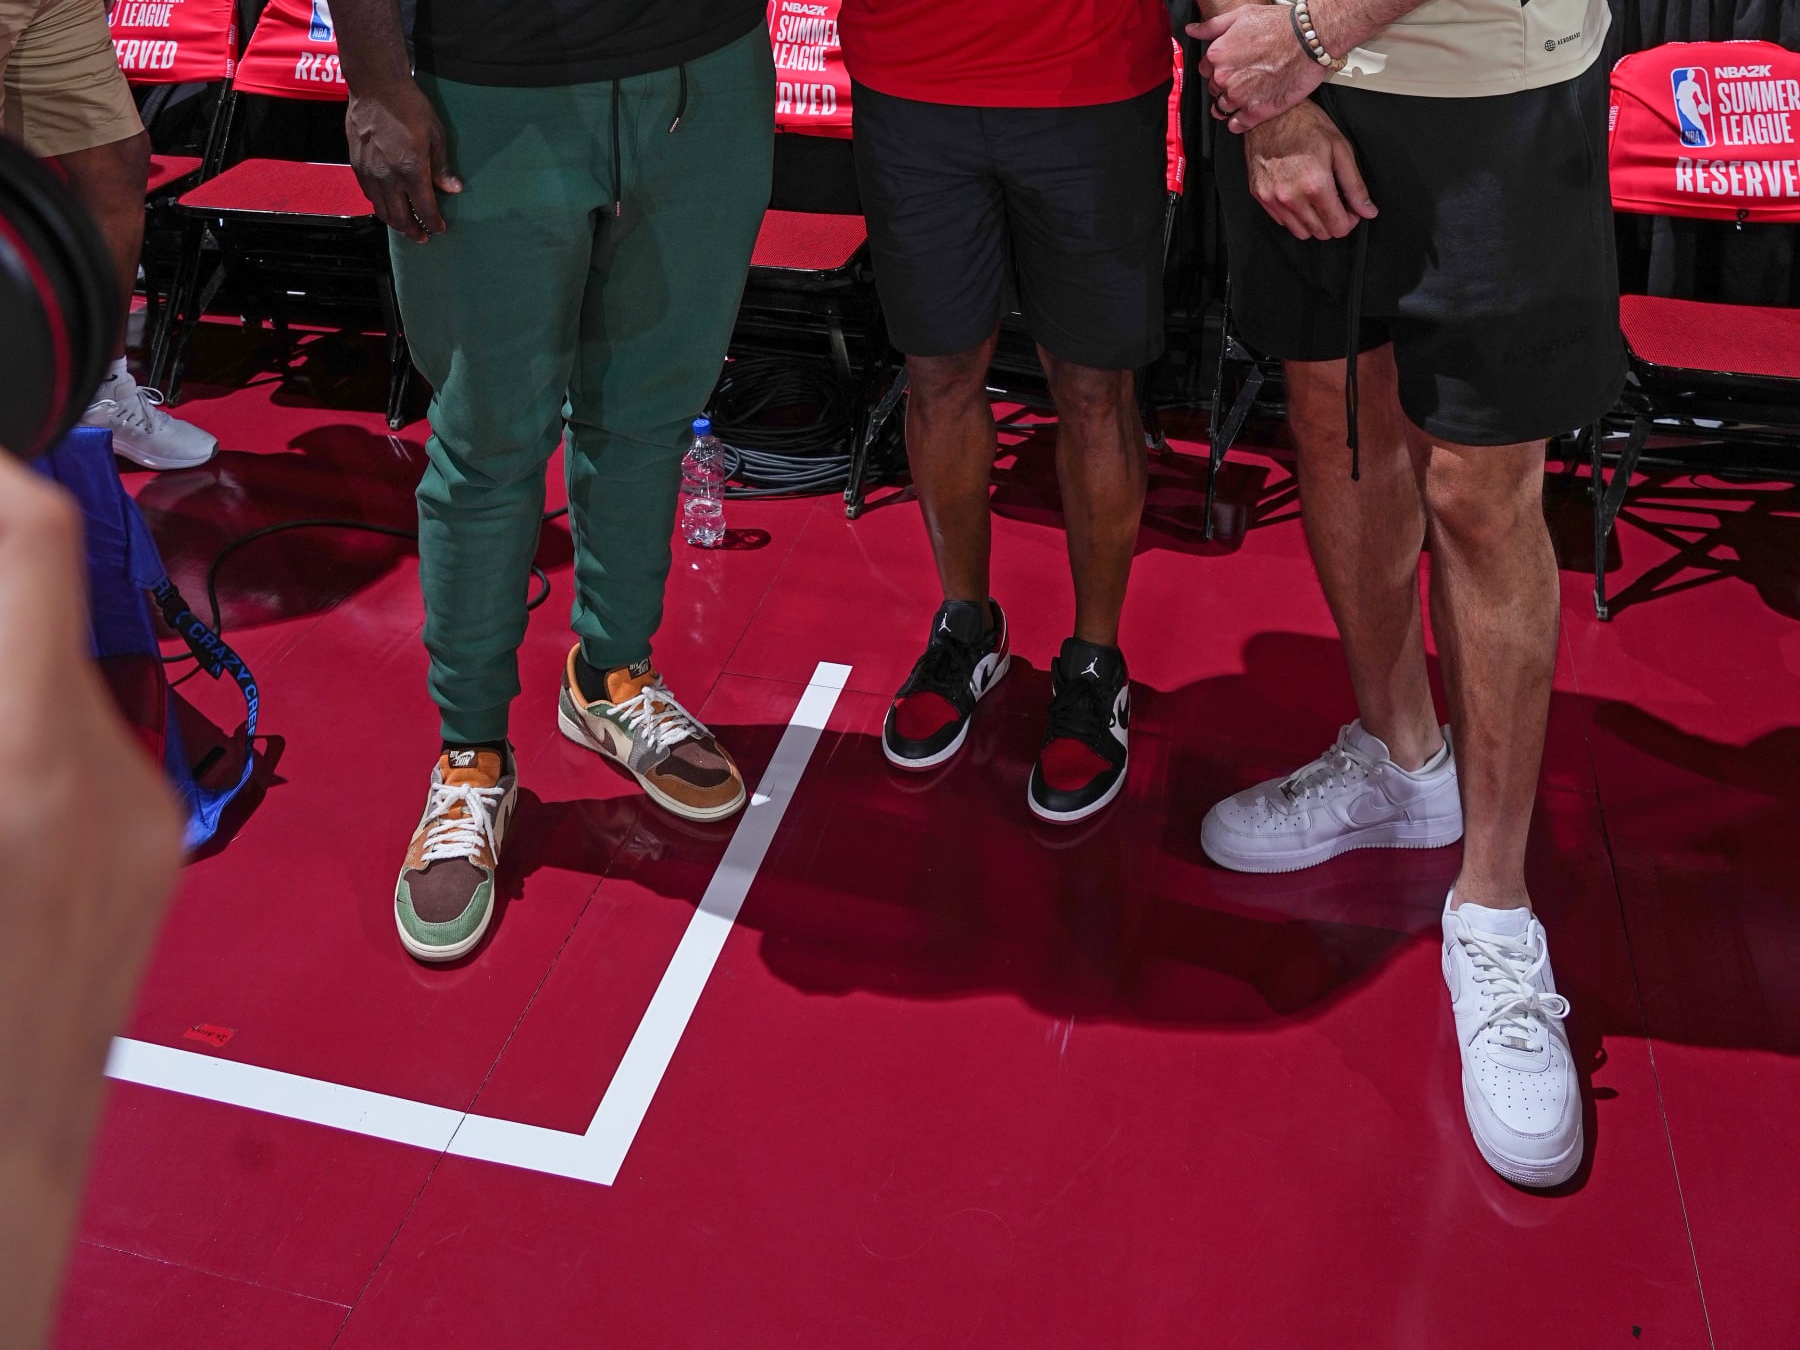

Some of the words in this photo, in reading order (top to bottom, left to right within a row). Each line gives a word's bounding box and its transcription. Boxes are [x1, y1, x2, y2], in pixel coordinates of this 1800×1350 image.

[121, 3, 175, 27] LEAGUE
[781, 1, 828, 16] NBA2K
[312, 27, 328, 39] NBA
[113, 39, 178, 70] ERVED
[773, 42, 827, 72] LEAGUE
[1714, 65, 1772, 79] NBA2K
[776, 81, 838, 116] RVED
[1717, 79, 1800, 115] SUMMER
[1721, 112, 1795, 147] LEAGUE
[1675, 156, 1800, 198] RESERVE
[188, 621, 251, 682] CRAZY
